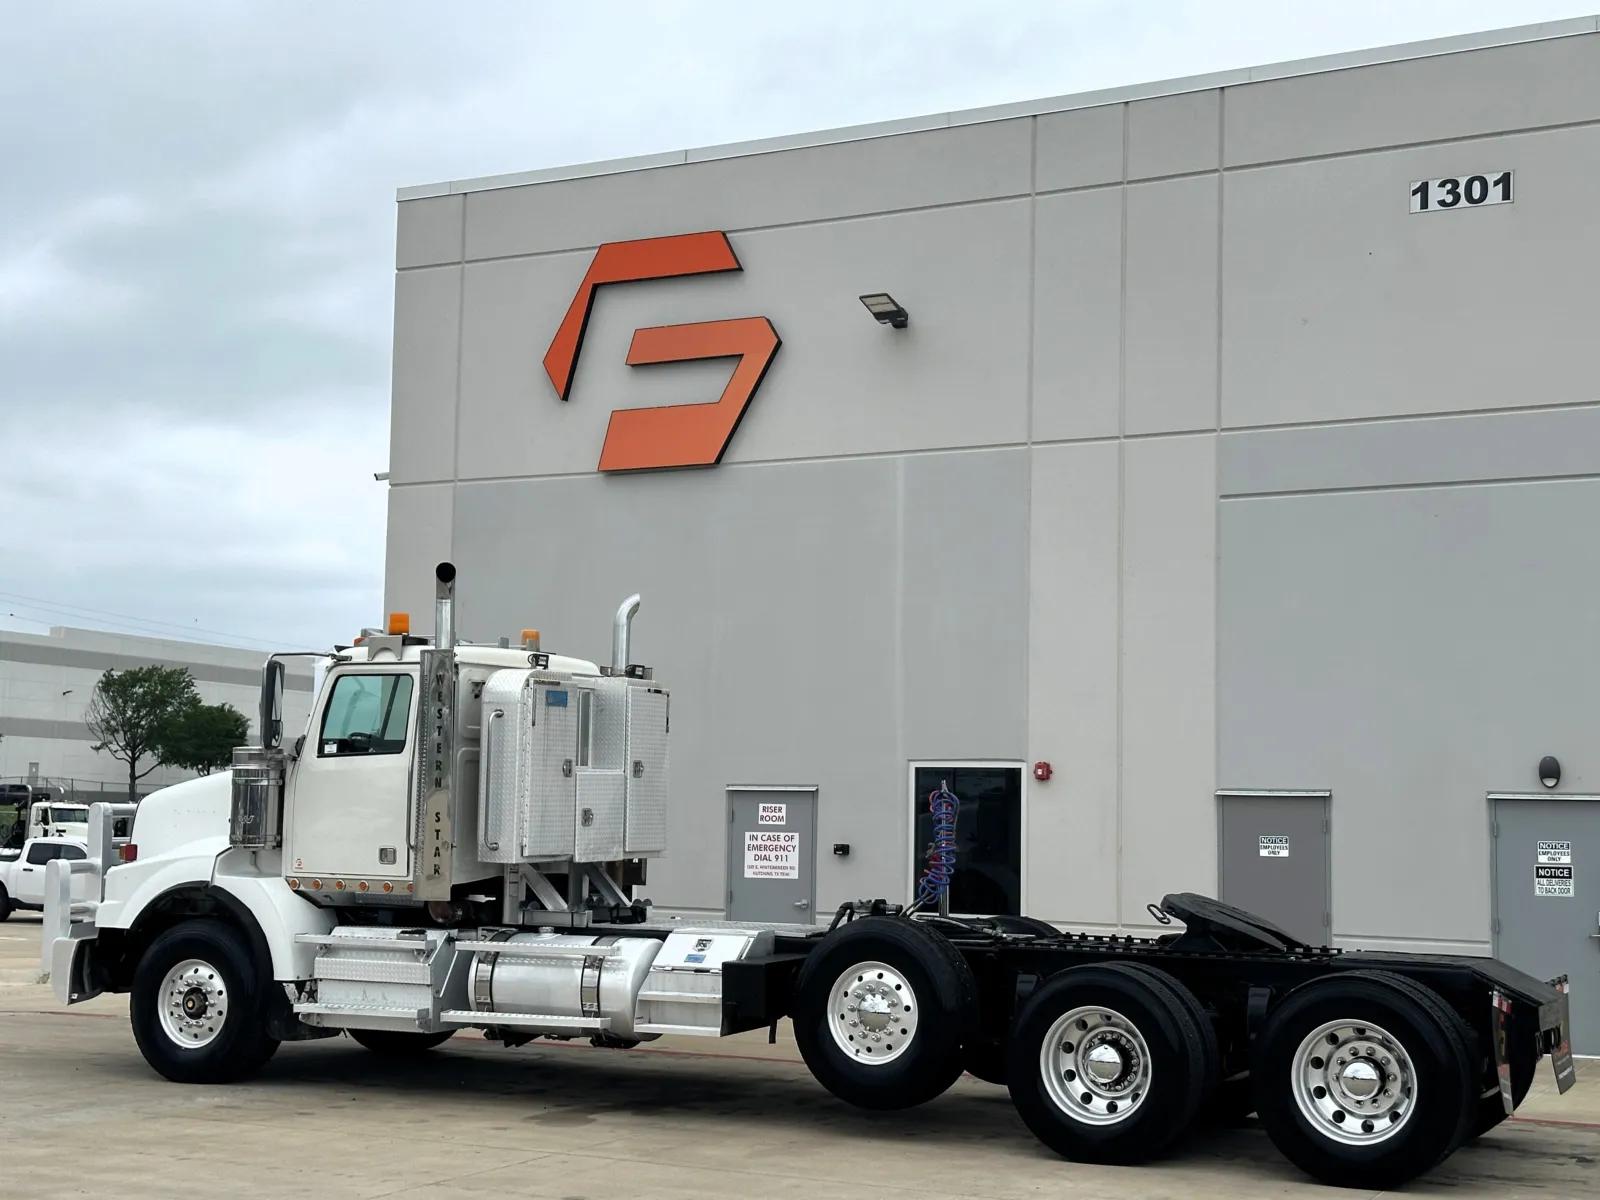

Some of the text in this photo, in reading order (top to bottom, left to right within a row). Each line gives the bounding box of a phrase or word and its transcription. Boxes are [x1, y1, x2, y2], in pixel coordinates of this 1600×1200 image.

[1411, 171, 1511, 210] 1301
[433, 674, 446, 876] WESTERN STAR
[762, 805, 783, 813] RISER
[759, 814, 785, 822] ROOM
[749, 834, 795, 842] IN CASE OF
[747, 843, 797, 852] EMERGENCY
[1539, 842, 1569, 850] NOTICE
[753, 853, 788, 862] DIAL 911
[1538, 868, 1570, 877] NOTICE
[1557, 887, 1571, 895] DOOR
